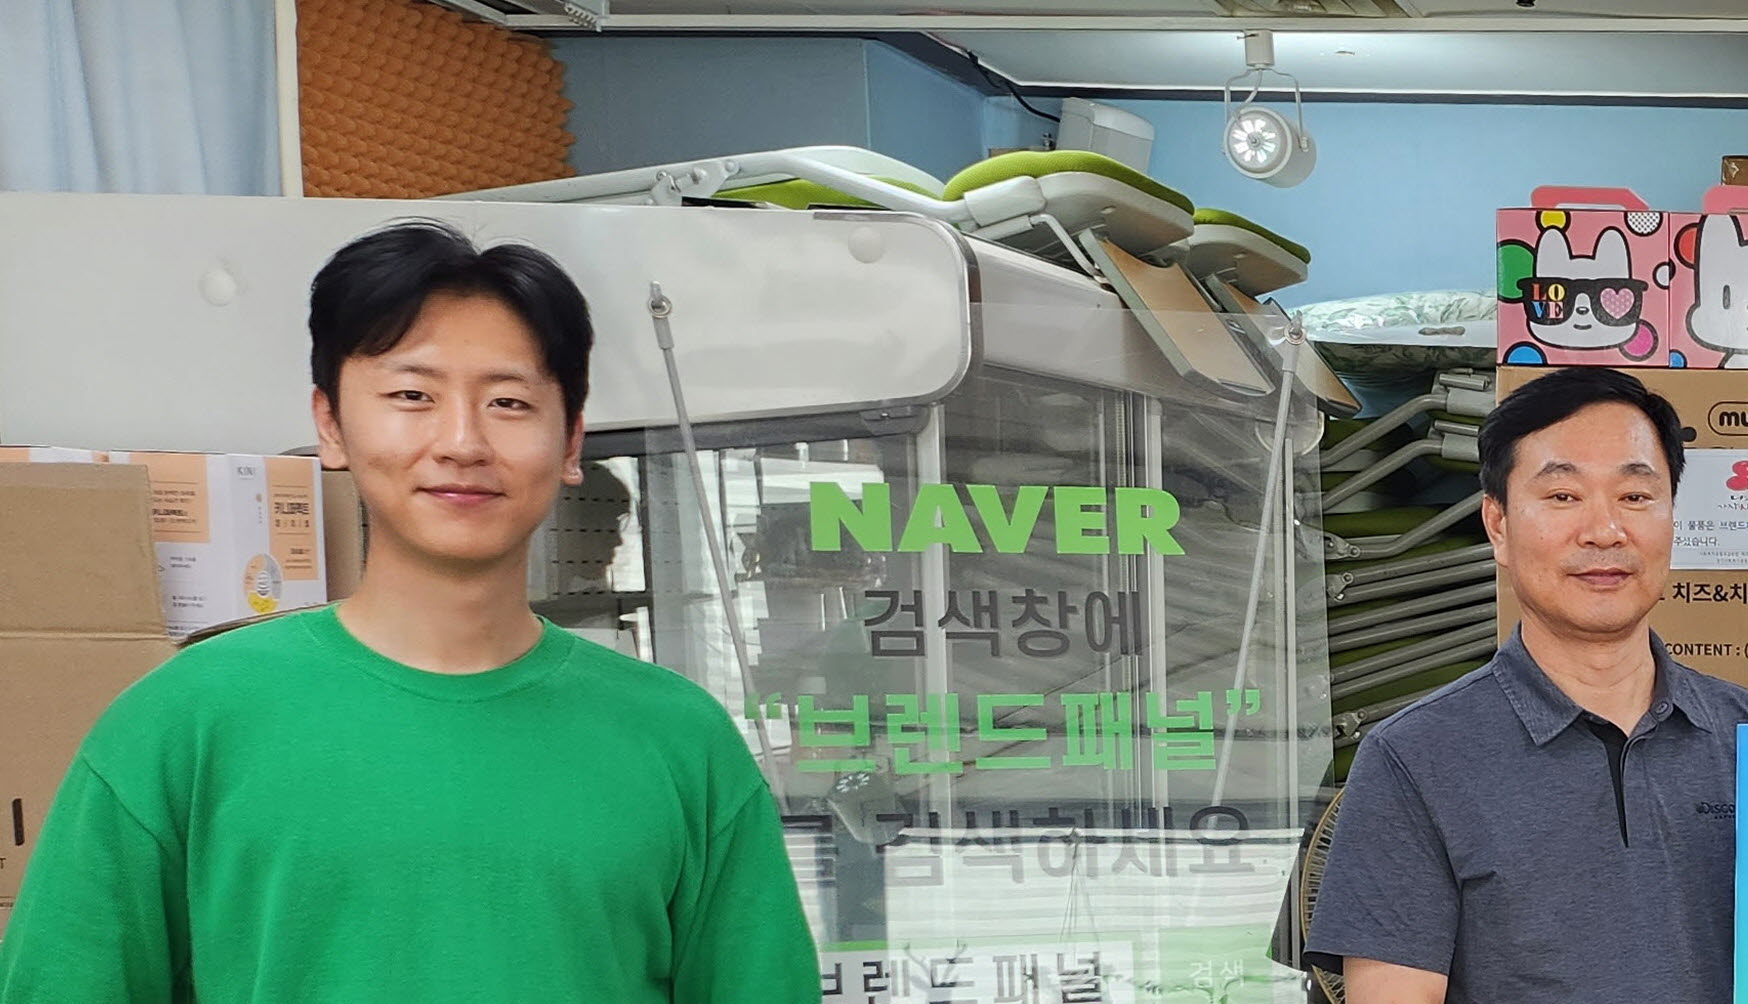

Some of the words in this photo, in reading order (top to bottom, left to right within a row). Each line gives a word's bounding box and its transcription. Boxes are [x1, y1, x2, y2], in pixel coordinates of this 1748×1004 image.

[809, 481, 1186, 556] NAVER
[864, 588, 1142, 657] 검색창에
[1666, 643, 1732, 657] CONTENT
[876, 805, 1255, 886] 검색하세요
